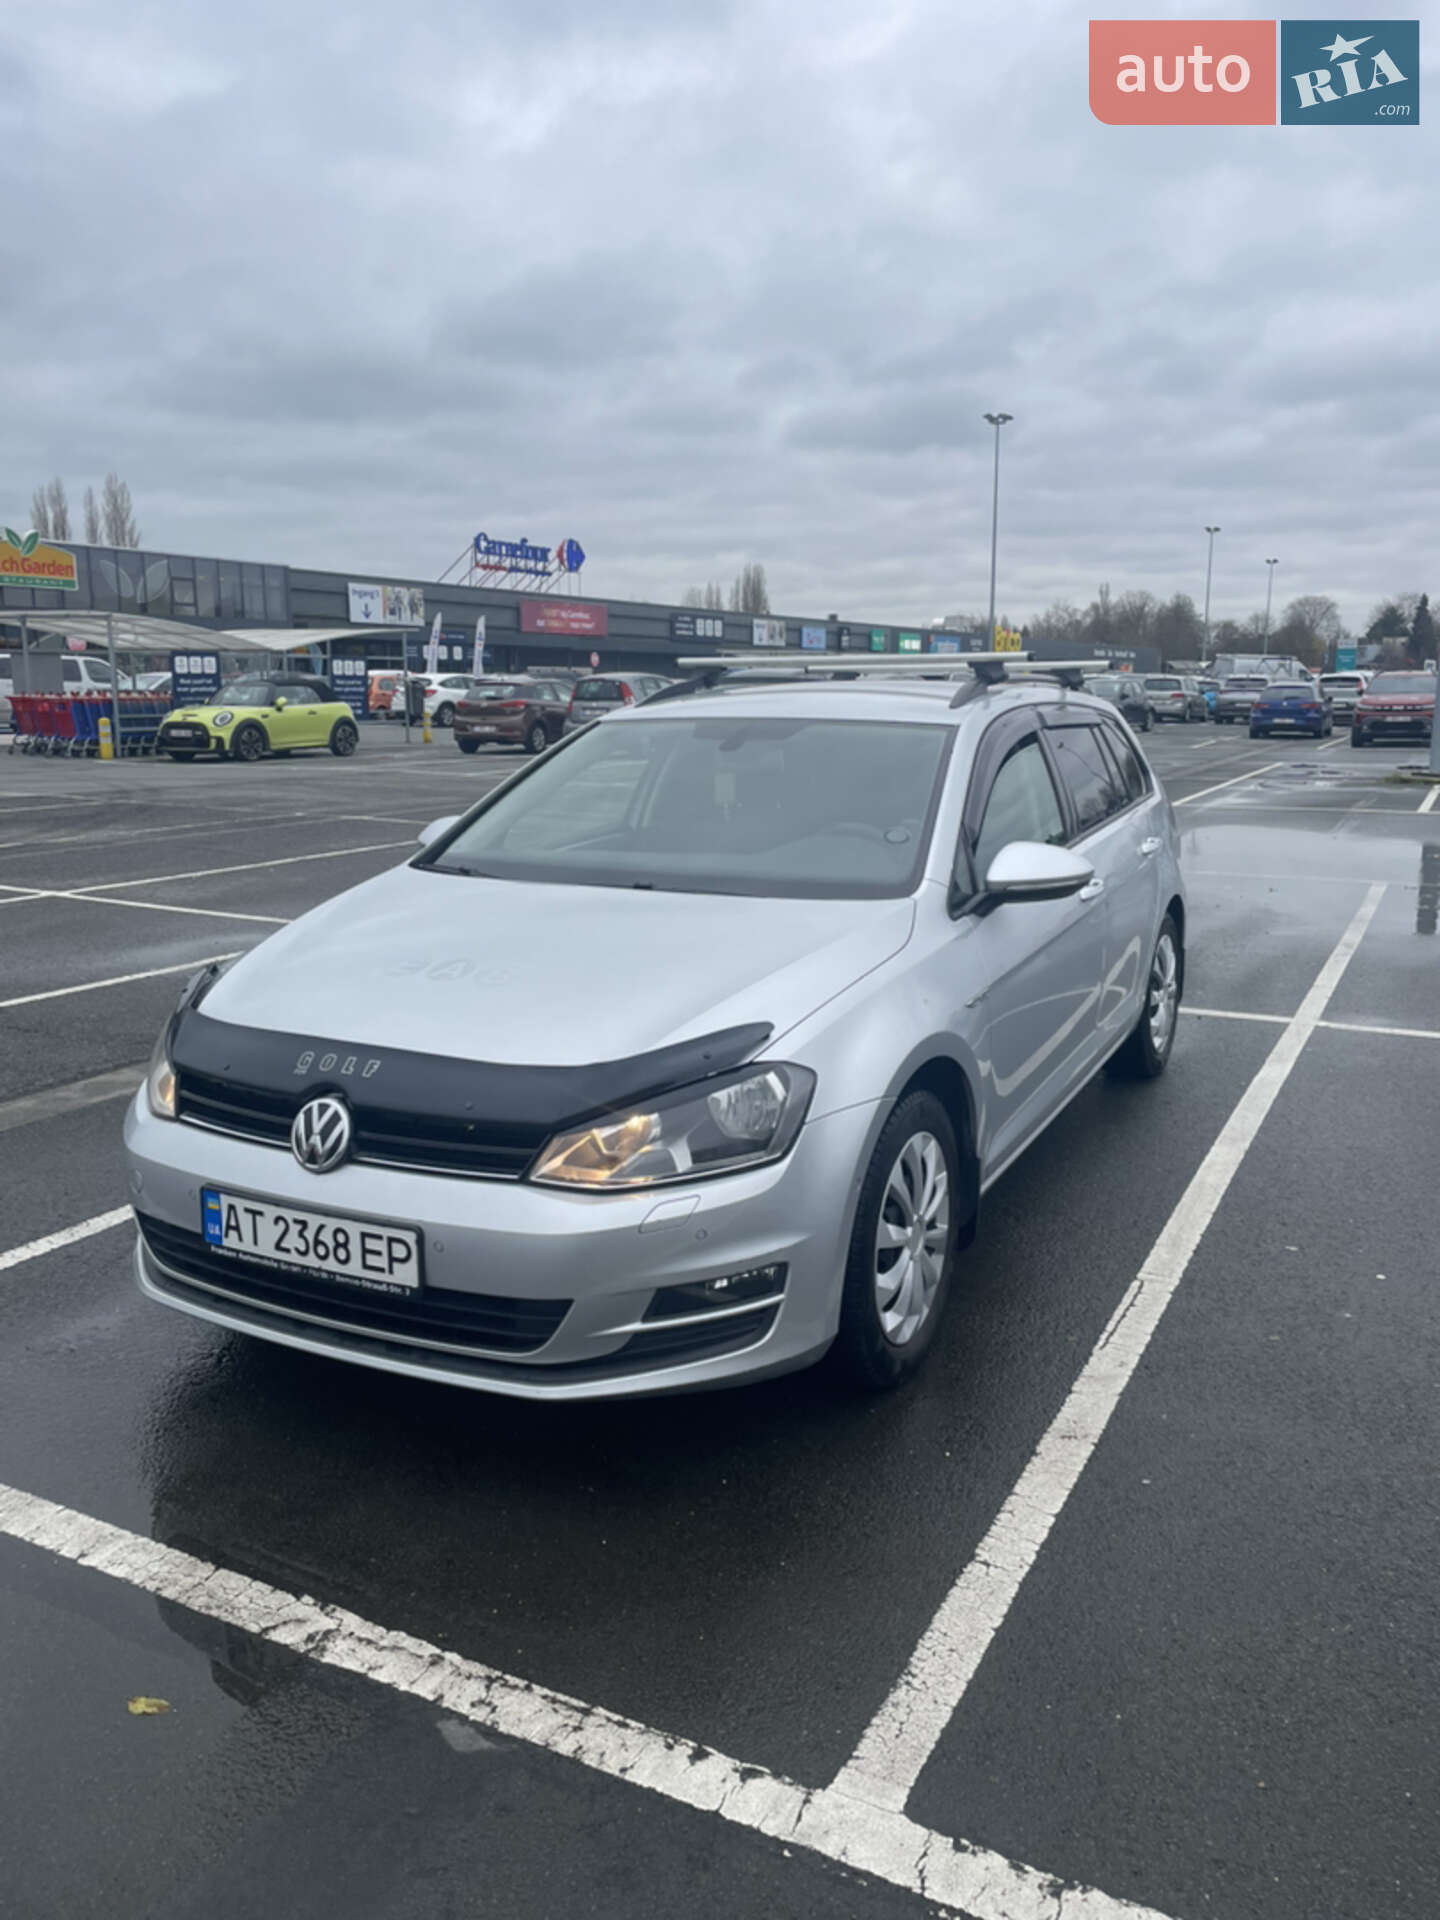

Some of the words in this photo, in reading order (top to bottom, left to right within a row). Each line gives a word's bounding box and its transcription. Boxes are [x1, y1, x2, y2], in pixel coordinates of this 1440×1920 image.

[474, 532, 551, 562] Carrefour
[21, 557, 75, 577] Garden
[297, 1051, 381, 1078] GOLF
[208, 1223, 221, 1236] UA
[224, 1204, 264, 1246] AT
[273, 1215, 352, 1265] 2368
[360, 1232, 412, 1275] EP
